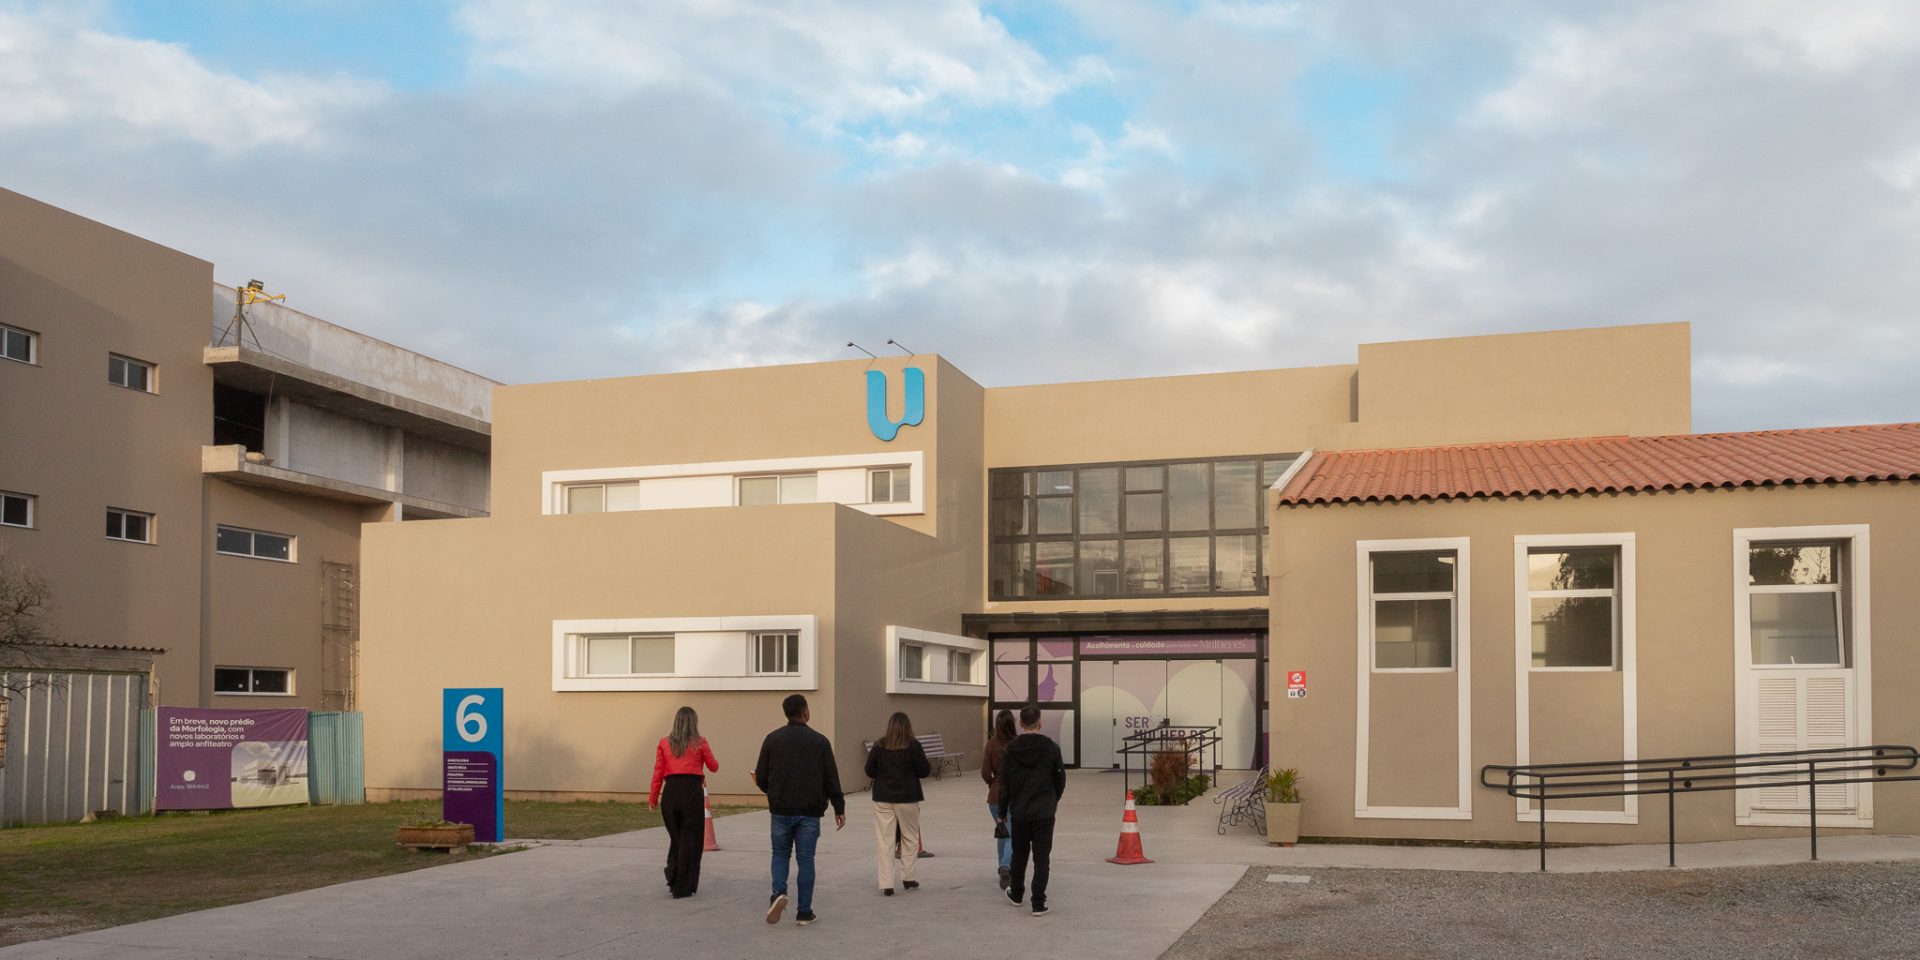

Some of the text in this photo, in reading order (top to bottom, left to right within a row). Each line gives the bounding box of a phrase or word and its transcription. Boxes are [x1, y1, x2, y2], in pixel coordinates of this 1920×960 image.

[1086, 641, 1130, 649] Acolhimento
[1135, 641, 1166, 649] cuidado
[170, 717, 184, 725] Em
[184, 717, 208, 726] breve,
[230, 718, 255, 727] prédio
[456, 694, 488, 743] 6
[1125, 716, 1149, 729] SER
[181, 725, 227, 734] Morfologia,
[194, 733, 239, 741] laboratórios
[195, 740, 233, 748] anfiteatro
